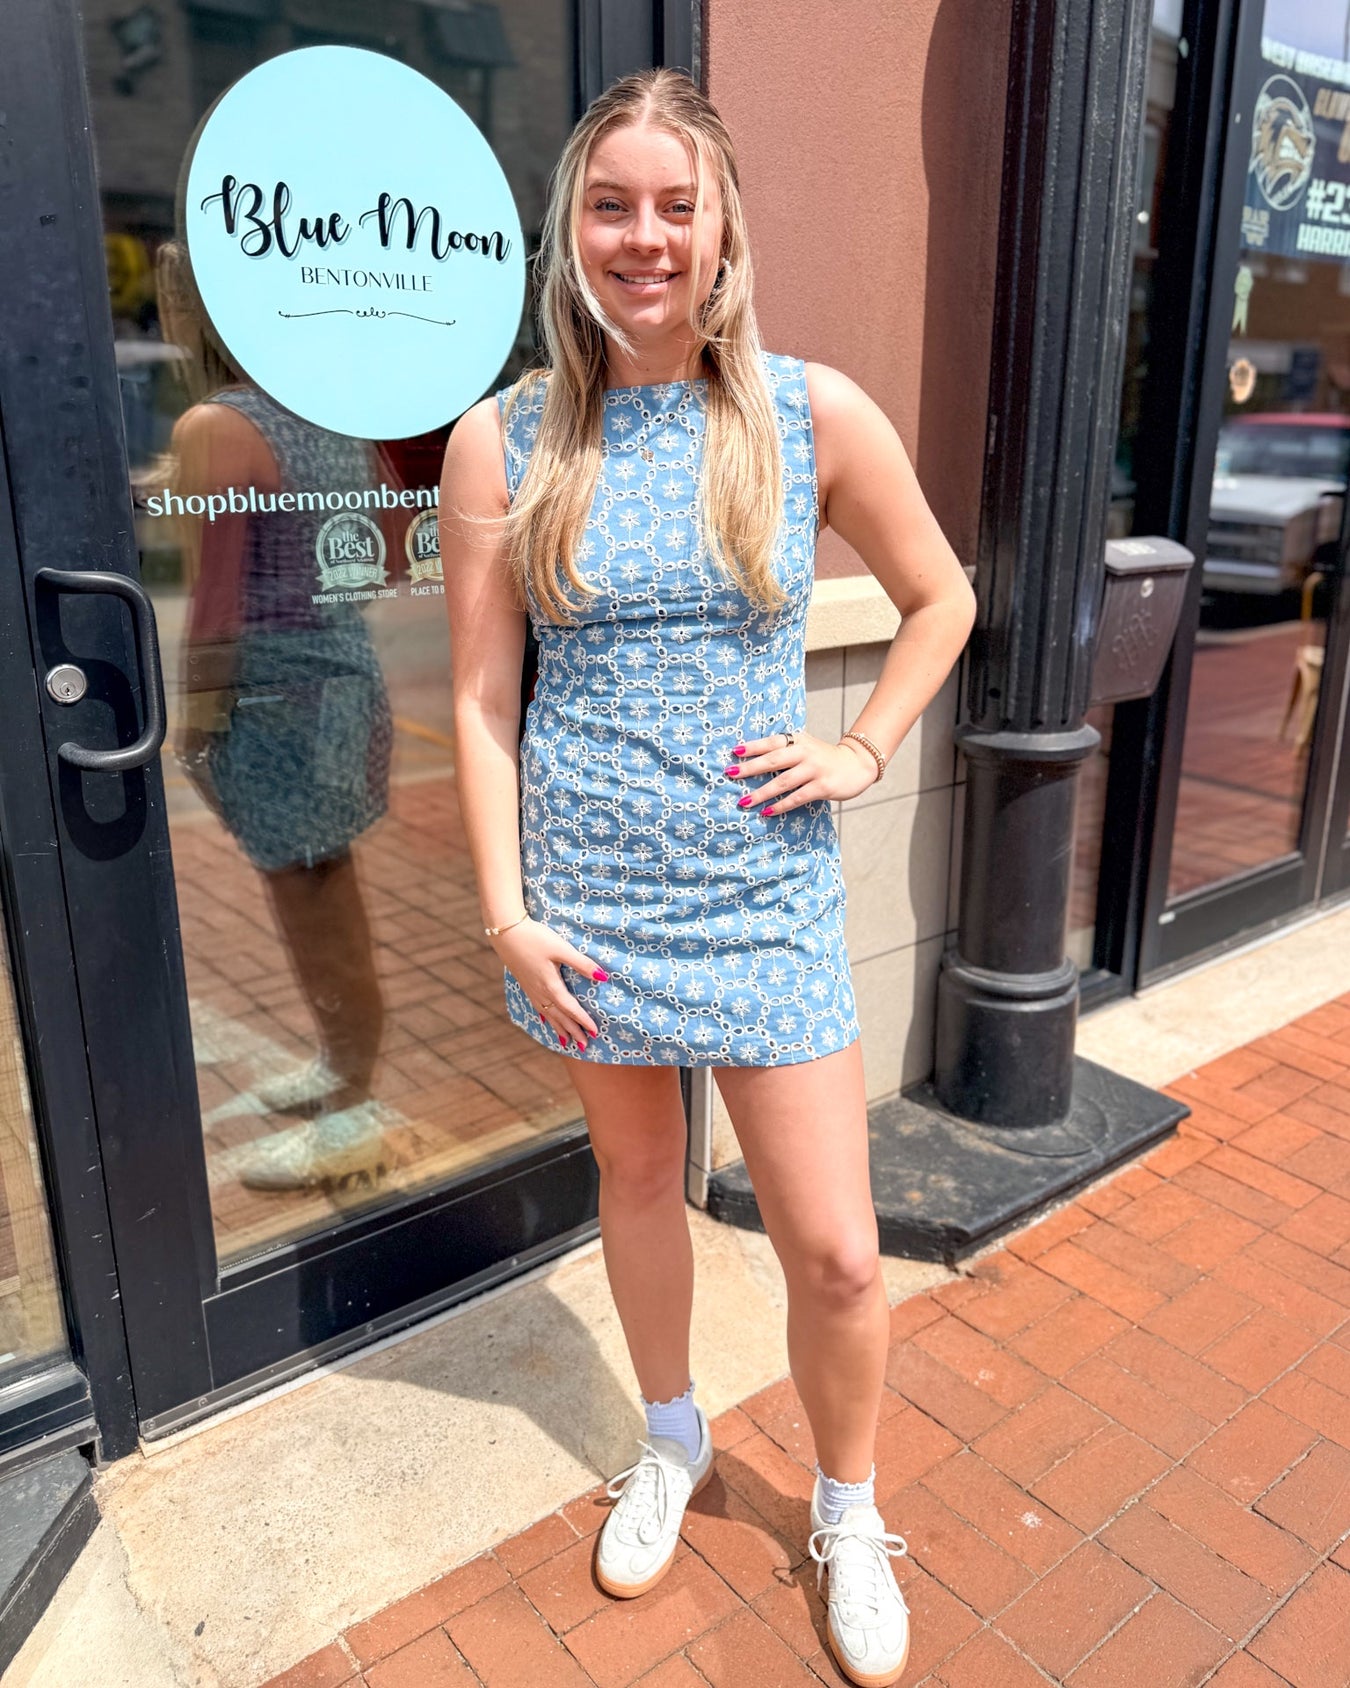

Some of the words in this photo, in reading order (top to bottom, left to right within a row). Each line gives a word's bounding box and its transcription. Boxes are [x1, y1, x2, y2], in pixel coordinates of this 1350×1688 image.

[201, 175, 350, 258] Blue
[359, 192, 511, 262] Moon
[301, 266, 433, 292] BENTONVILLE
[342, 530, 359, 542] the
[328, 537, 375, 560] Best
[311, 593, 344, 604] WOMEN'S
[345, 590, 376, 601] CLOTHING
[377, 588, 398, 598] STORE
[410, 586, 431, 596] PLACE
